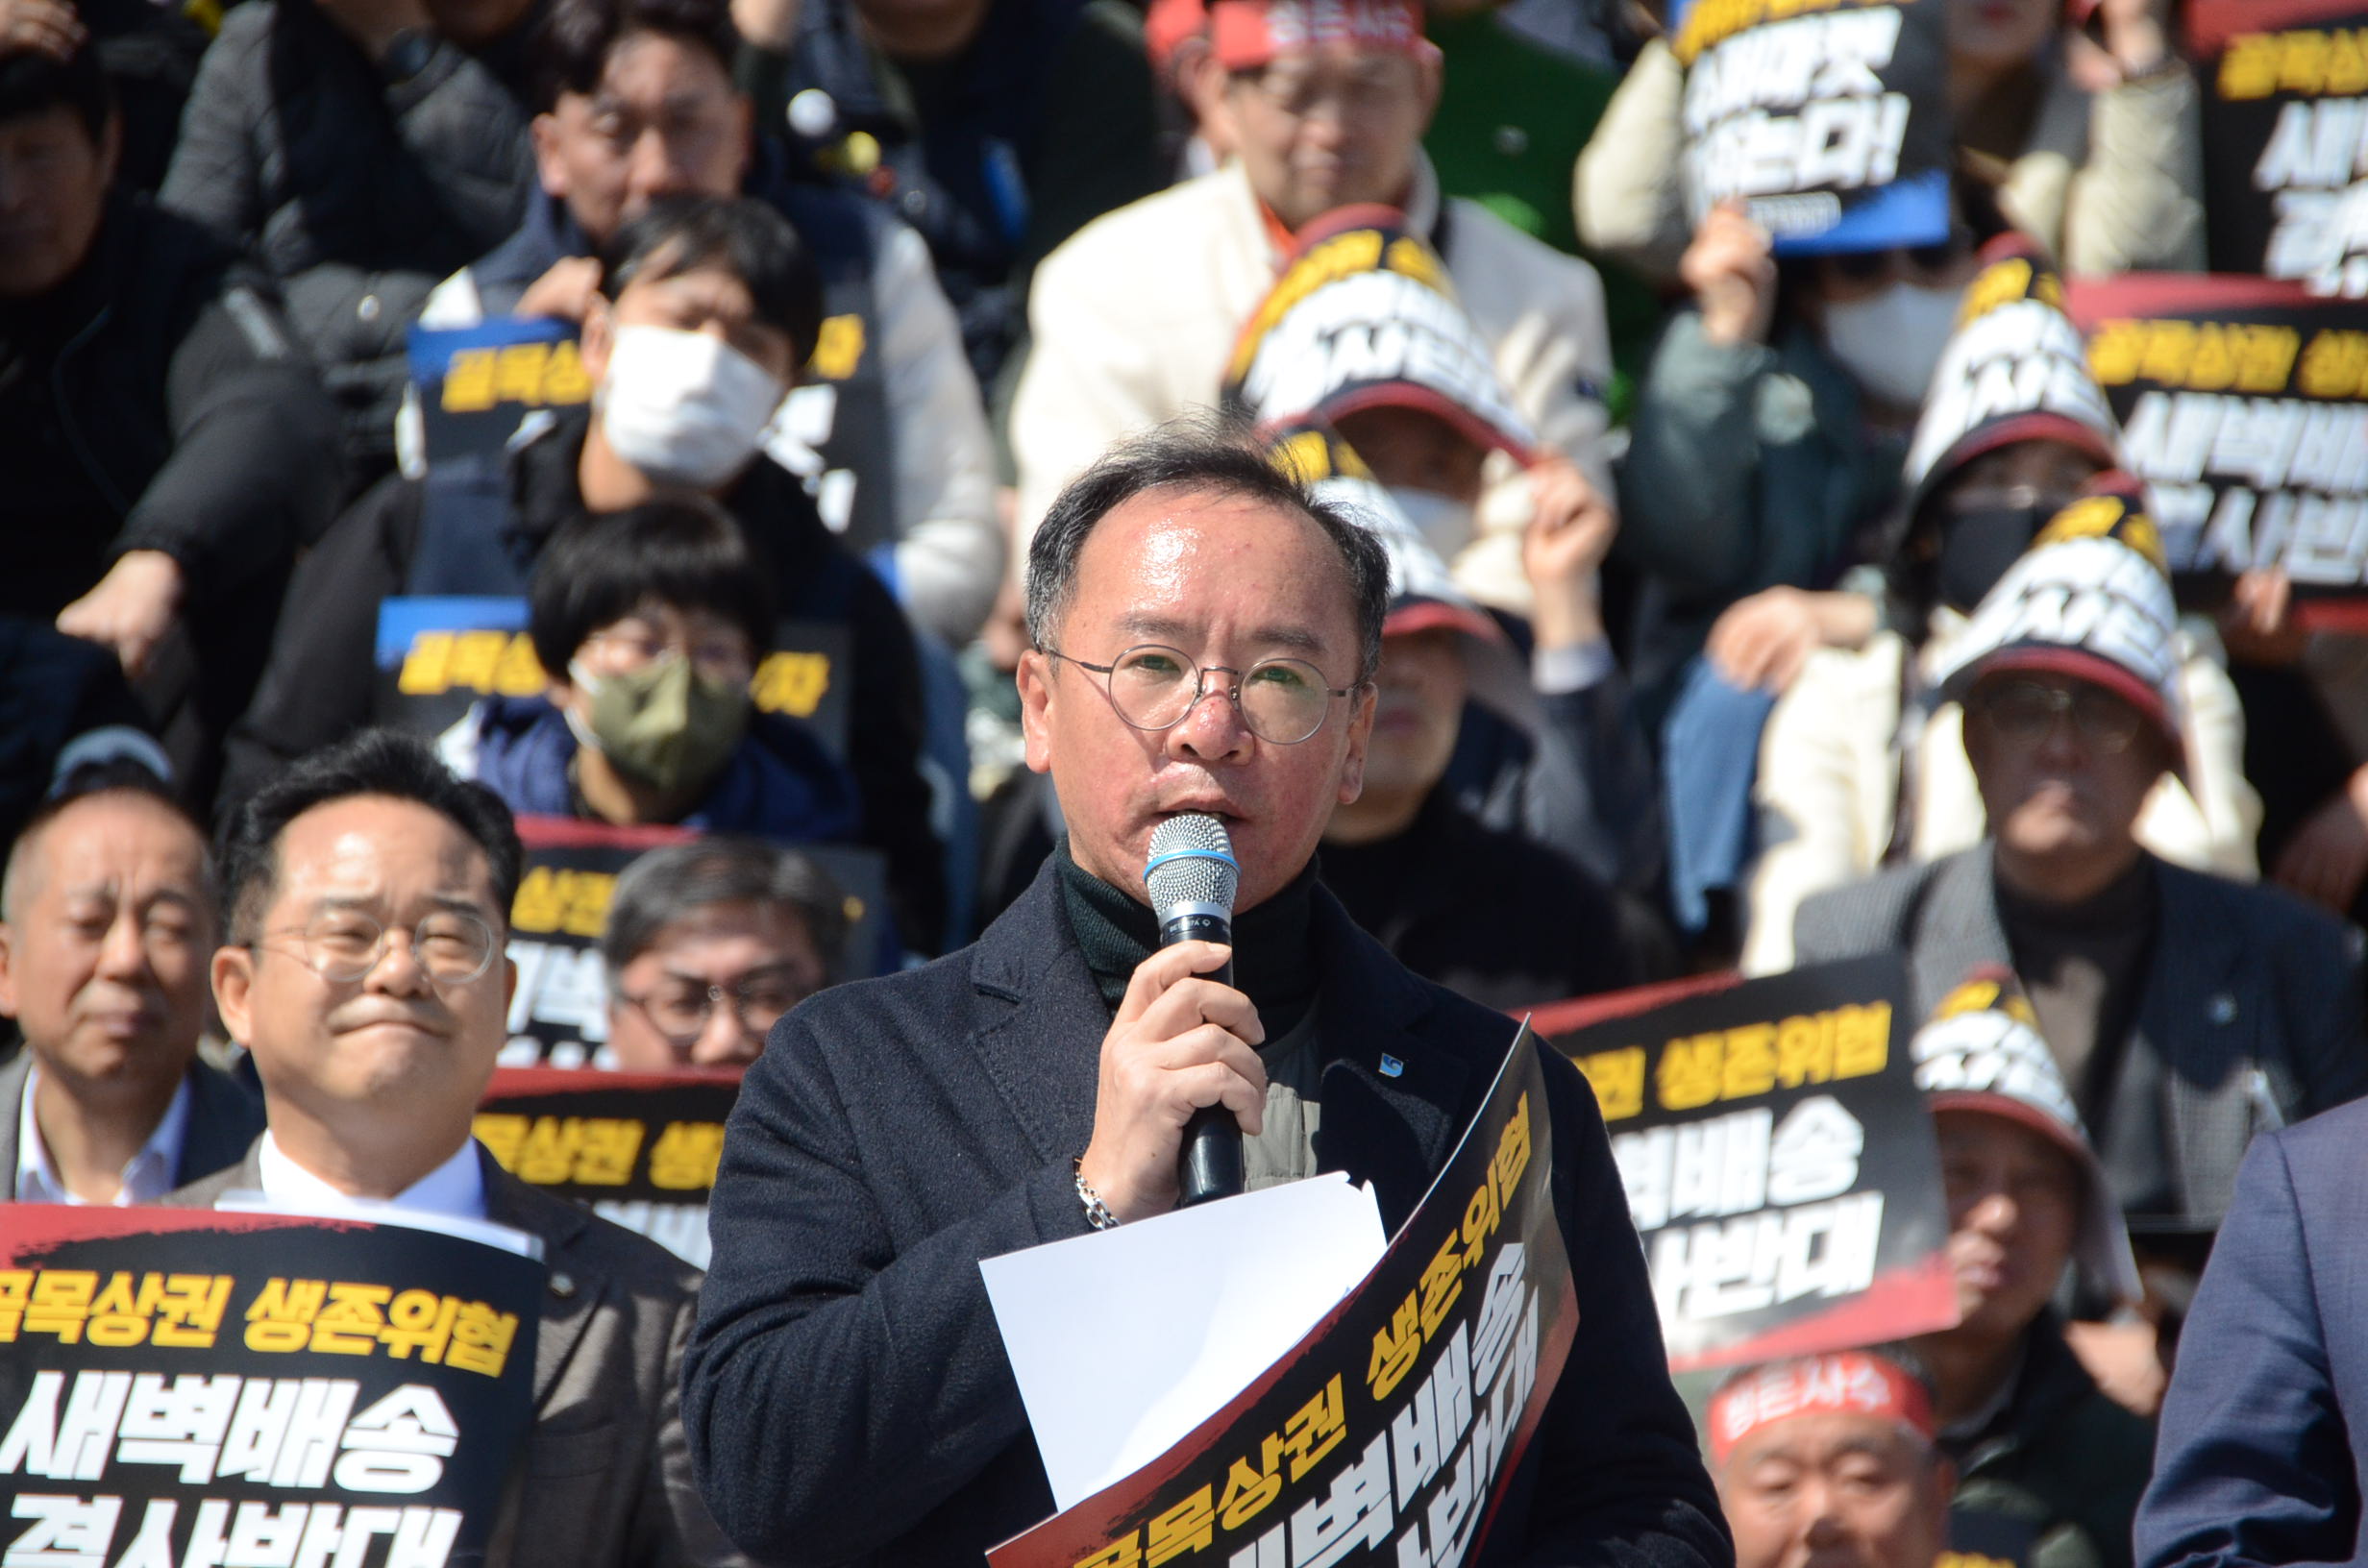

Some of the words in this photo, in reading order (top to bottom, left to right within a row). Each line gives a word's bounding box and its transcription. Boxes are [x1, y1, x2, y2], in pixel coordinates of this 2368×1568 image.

[1655, 999, 1892, 1111] 생존위협
[1366, 1090, 1532, 1403] 생존위협
[244, 1277, 520, 1378] 생존위협
[0, 1369, 460, 1494] 새벽배송
